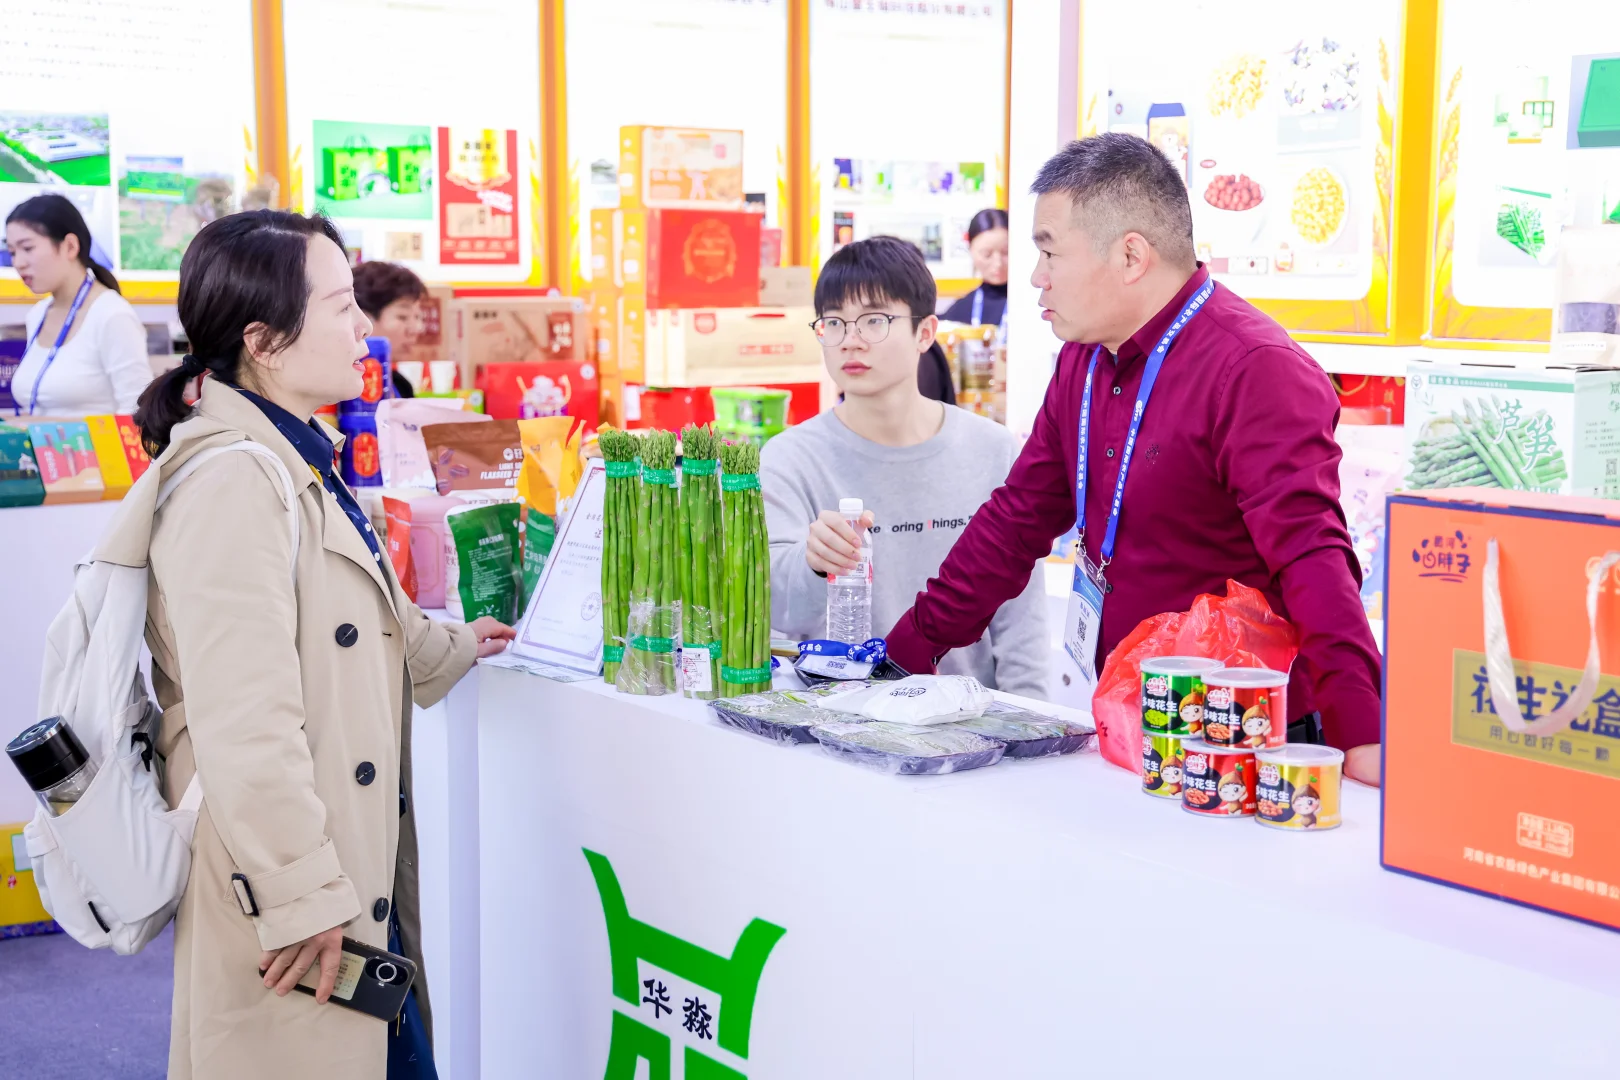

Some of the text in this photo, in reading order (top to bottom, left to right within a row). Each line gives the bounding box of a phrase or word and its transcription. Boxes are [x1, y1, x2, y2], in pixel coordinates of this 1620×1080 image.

[1078, 401, 1088, 490] 中国国际农产品交易会
[1112, 428, 1136, 516] 中国国际农产品交易会
[1494, 399, 1556, 474] 芦笋
[643, 979, 712, 1040] 华淼
